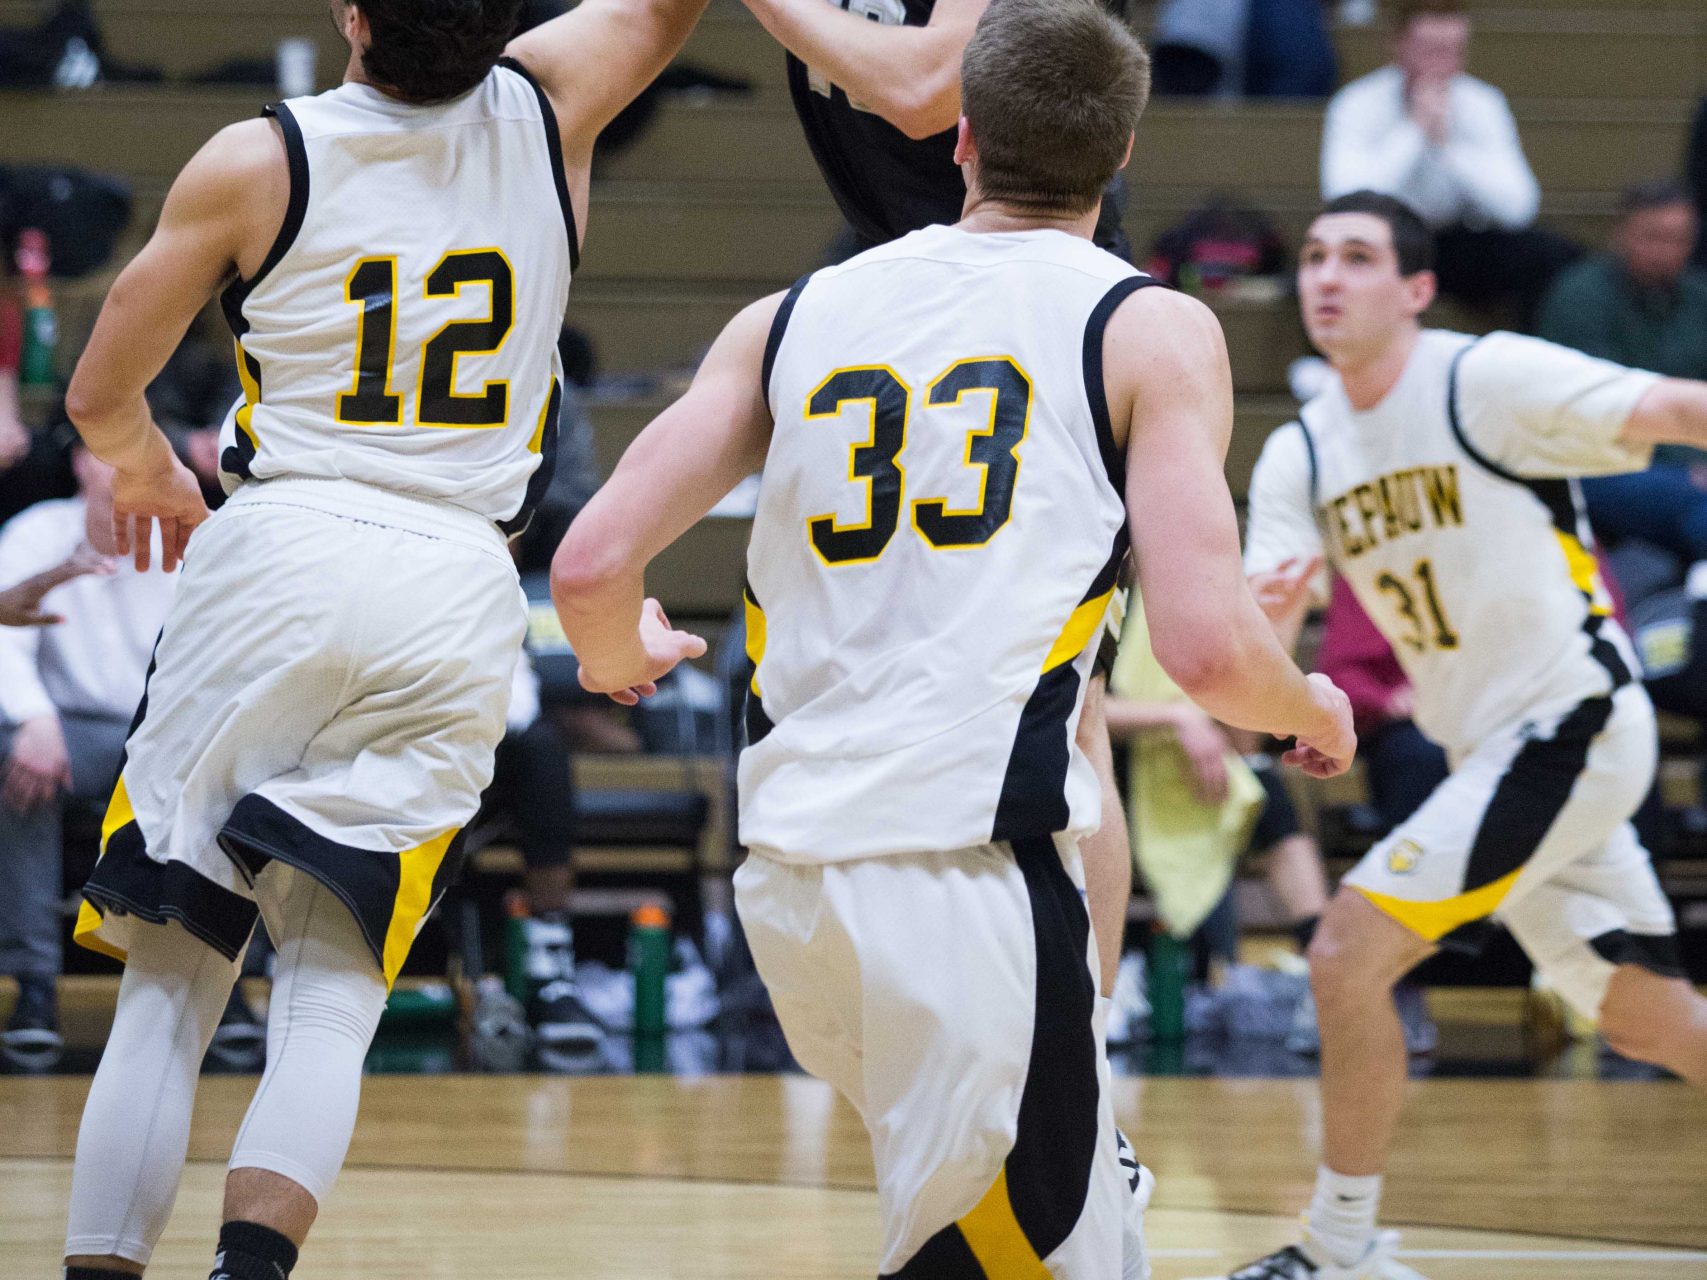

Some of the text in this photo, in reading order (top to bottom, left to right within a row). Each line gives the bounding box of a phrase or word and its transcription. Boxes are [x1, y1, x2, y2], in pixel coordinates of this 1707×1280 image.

[336, 247, 514, 429] 12
[805, 355, 1034, 566] 33
[1375, 558, 1459, 653] 31
